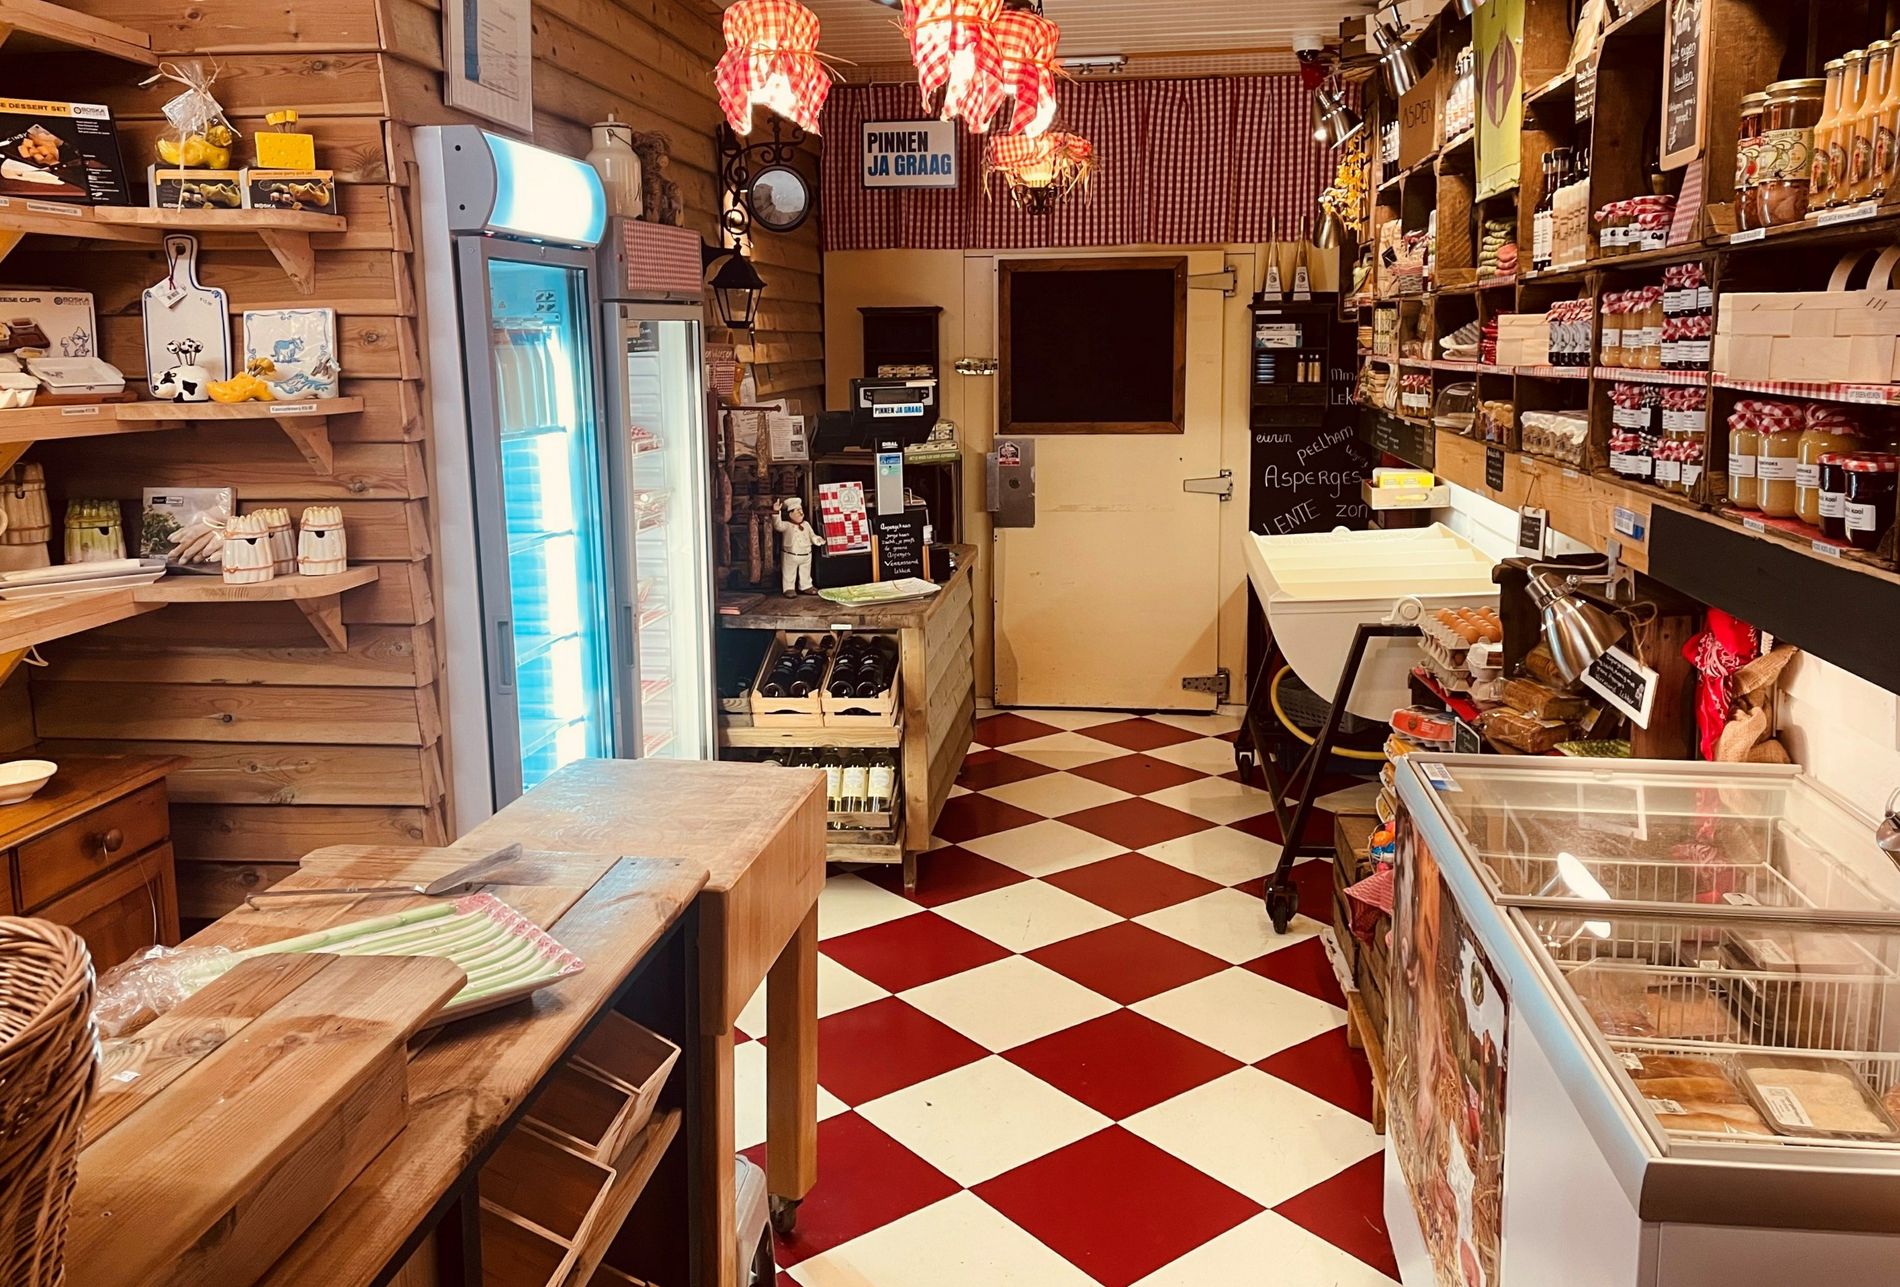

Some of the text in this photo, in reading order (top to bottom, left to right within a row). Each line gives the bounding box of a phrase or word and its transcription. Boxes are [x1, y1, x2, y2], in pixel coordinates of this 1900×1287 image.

[1680, 42, 1697, 67] eigen
[8, 103, 48, 111] DESSERT
[867, 131, 928, 153] PINNEN
[867, 154, 952, 176] JA GRAAG
[904, 405, 922, 413] GRAAG
